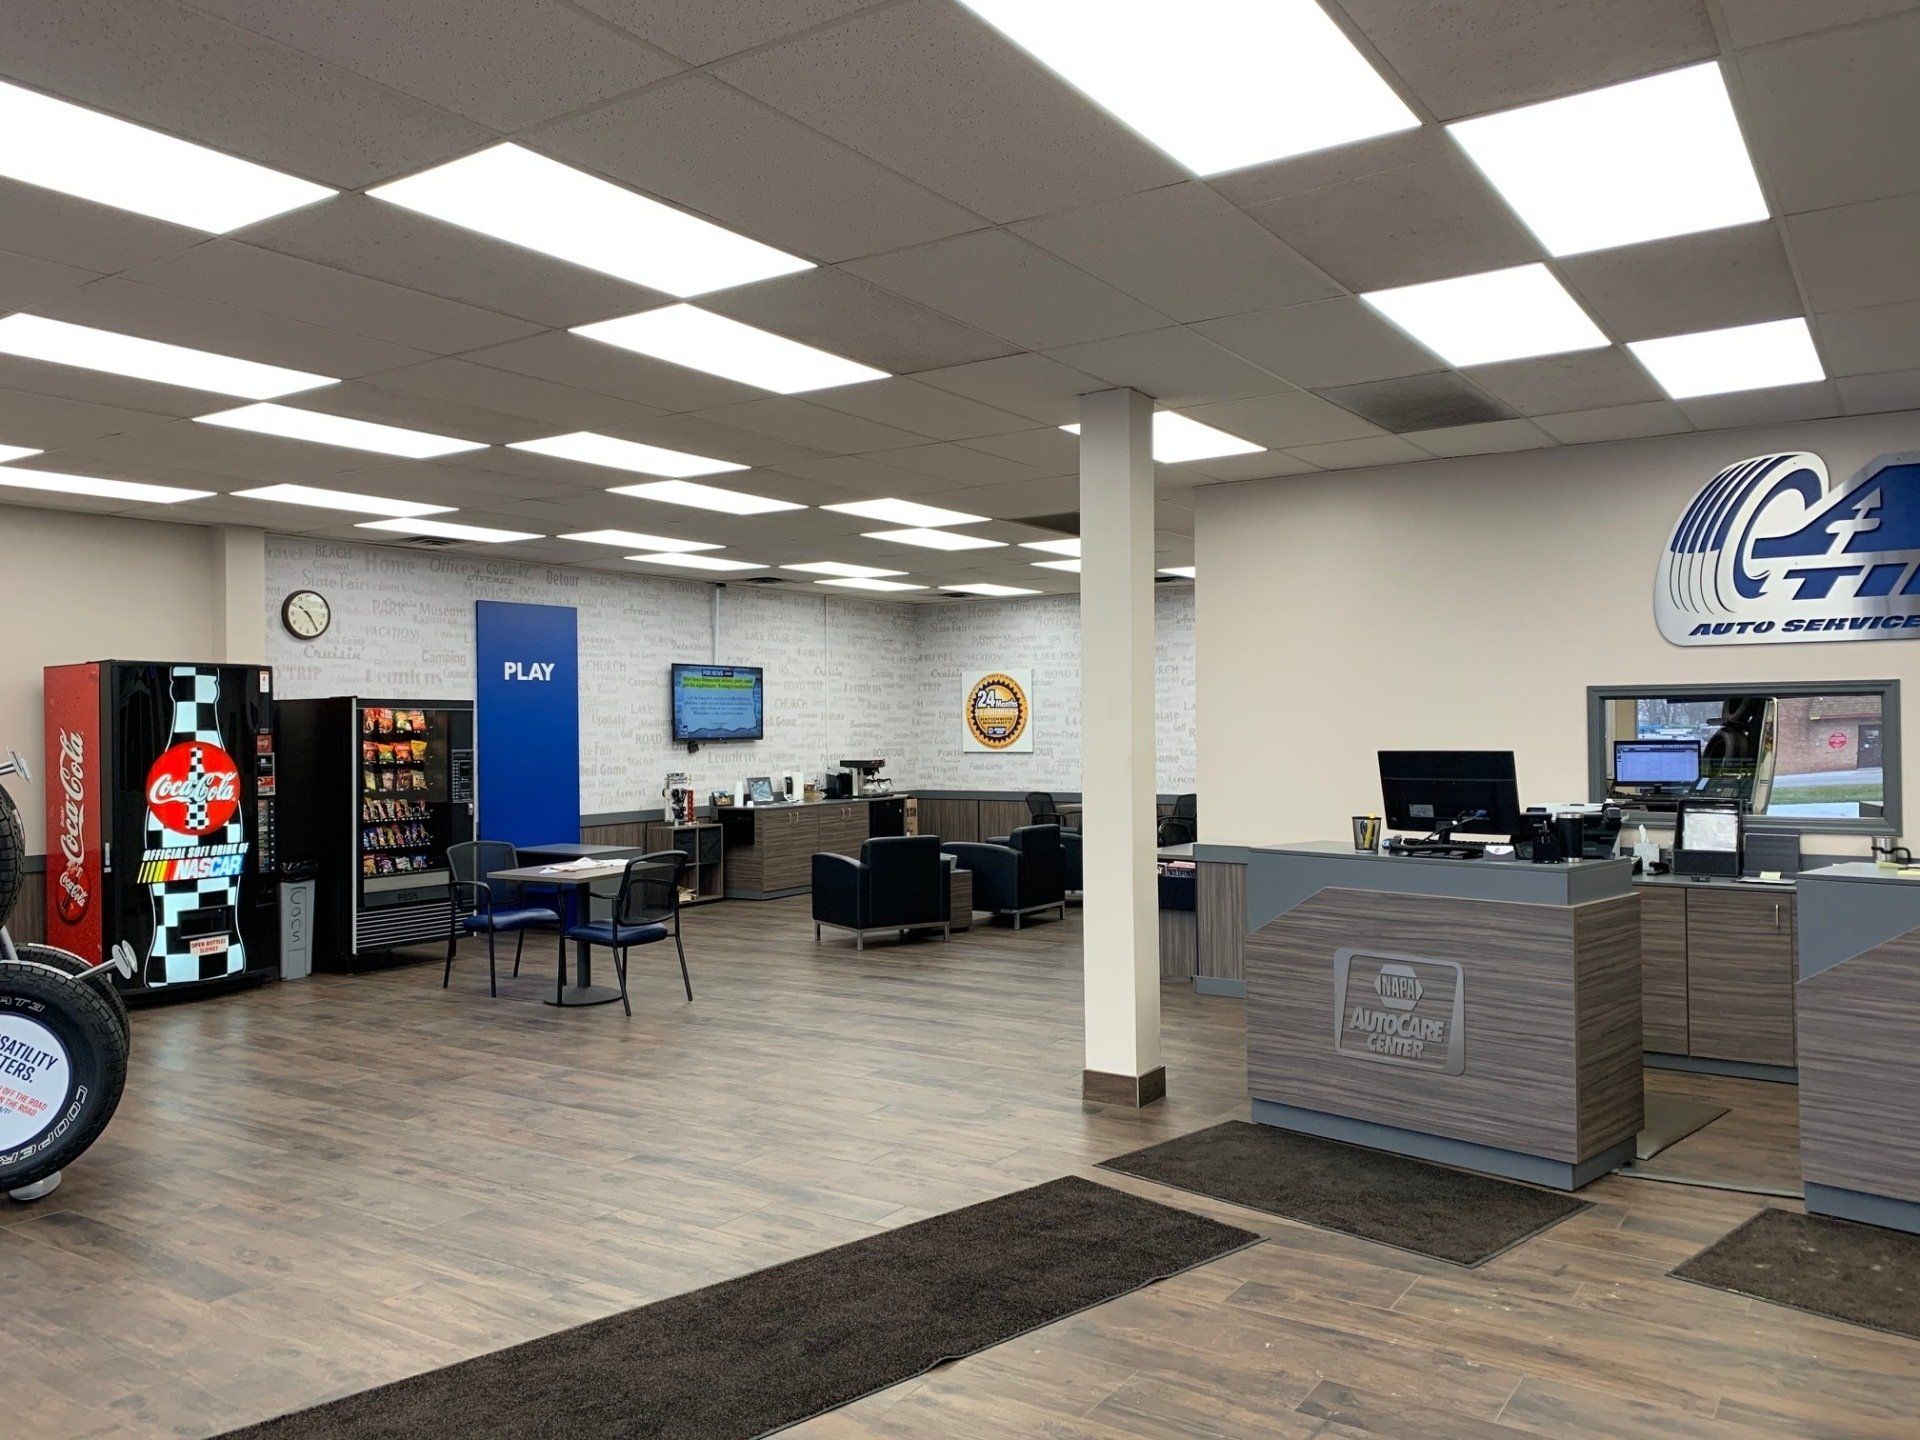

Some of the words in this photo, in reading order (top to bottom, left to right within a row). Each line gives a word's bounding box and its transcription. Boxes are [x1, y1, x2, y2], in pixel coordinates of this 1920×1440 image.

[364, 551, 416, 574] Home
[546, 569, 580, 587] Detour
[1688, 620, 1776, 636] AUTO
[503, 661, 556, 683] PLAY
[976, 689, 996, 709] 24
[60, 726, 85, 866] Coca-Cola
[149, 772, 239, 806] Coca-Cola
[142, 847, 187, 862] OFFICIAL
[187, 845, 210, 859] SOFT
[210, 842, 238, 856] DRINK
[238, 841, 250, 854] OF
[176, 855, 243, 880] NASCAR
[1381, 975, 1417, 1000] NAPA
[0, 1035, 59, 1071] SATILITY
[1367, 1032, 1425, 1060] CENTER
[0, 1053, 35, 1084] TERS.
[0, 1084, 88, 1168] COOPER
